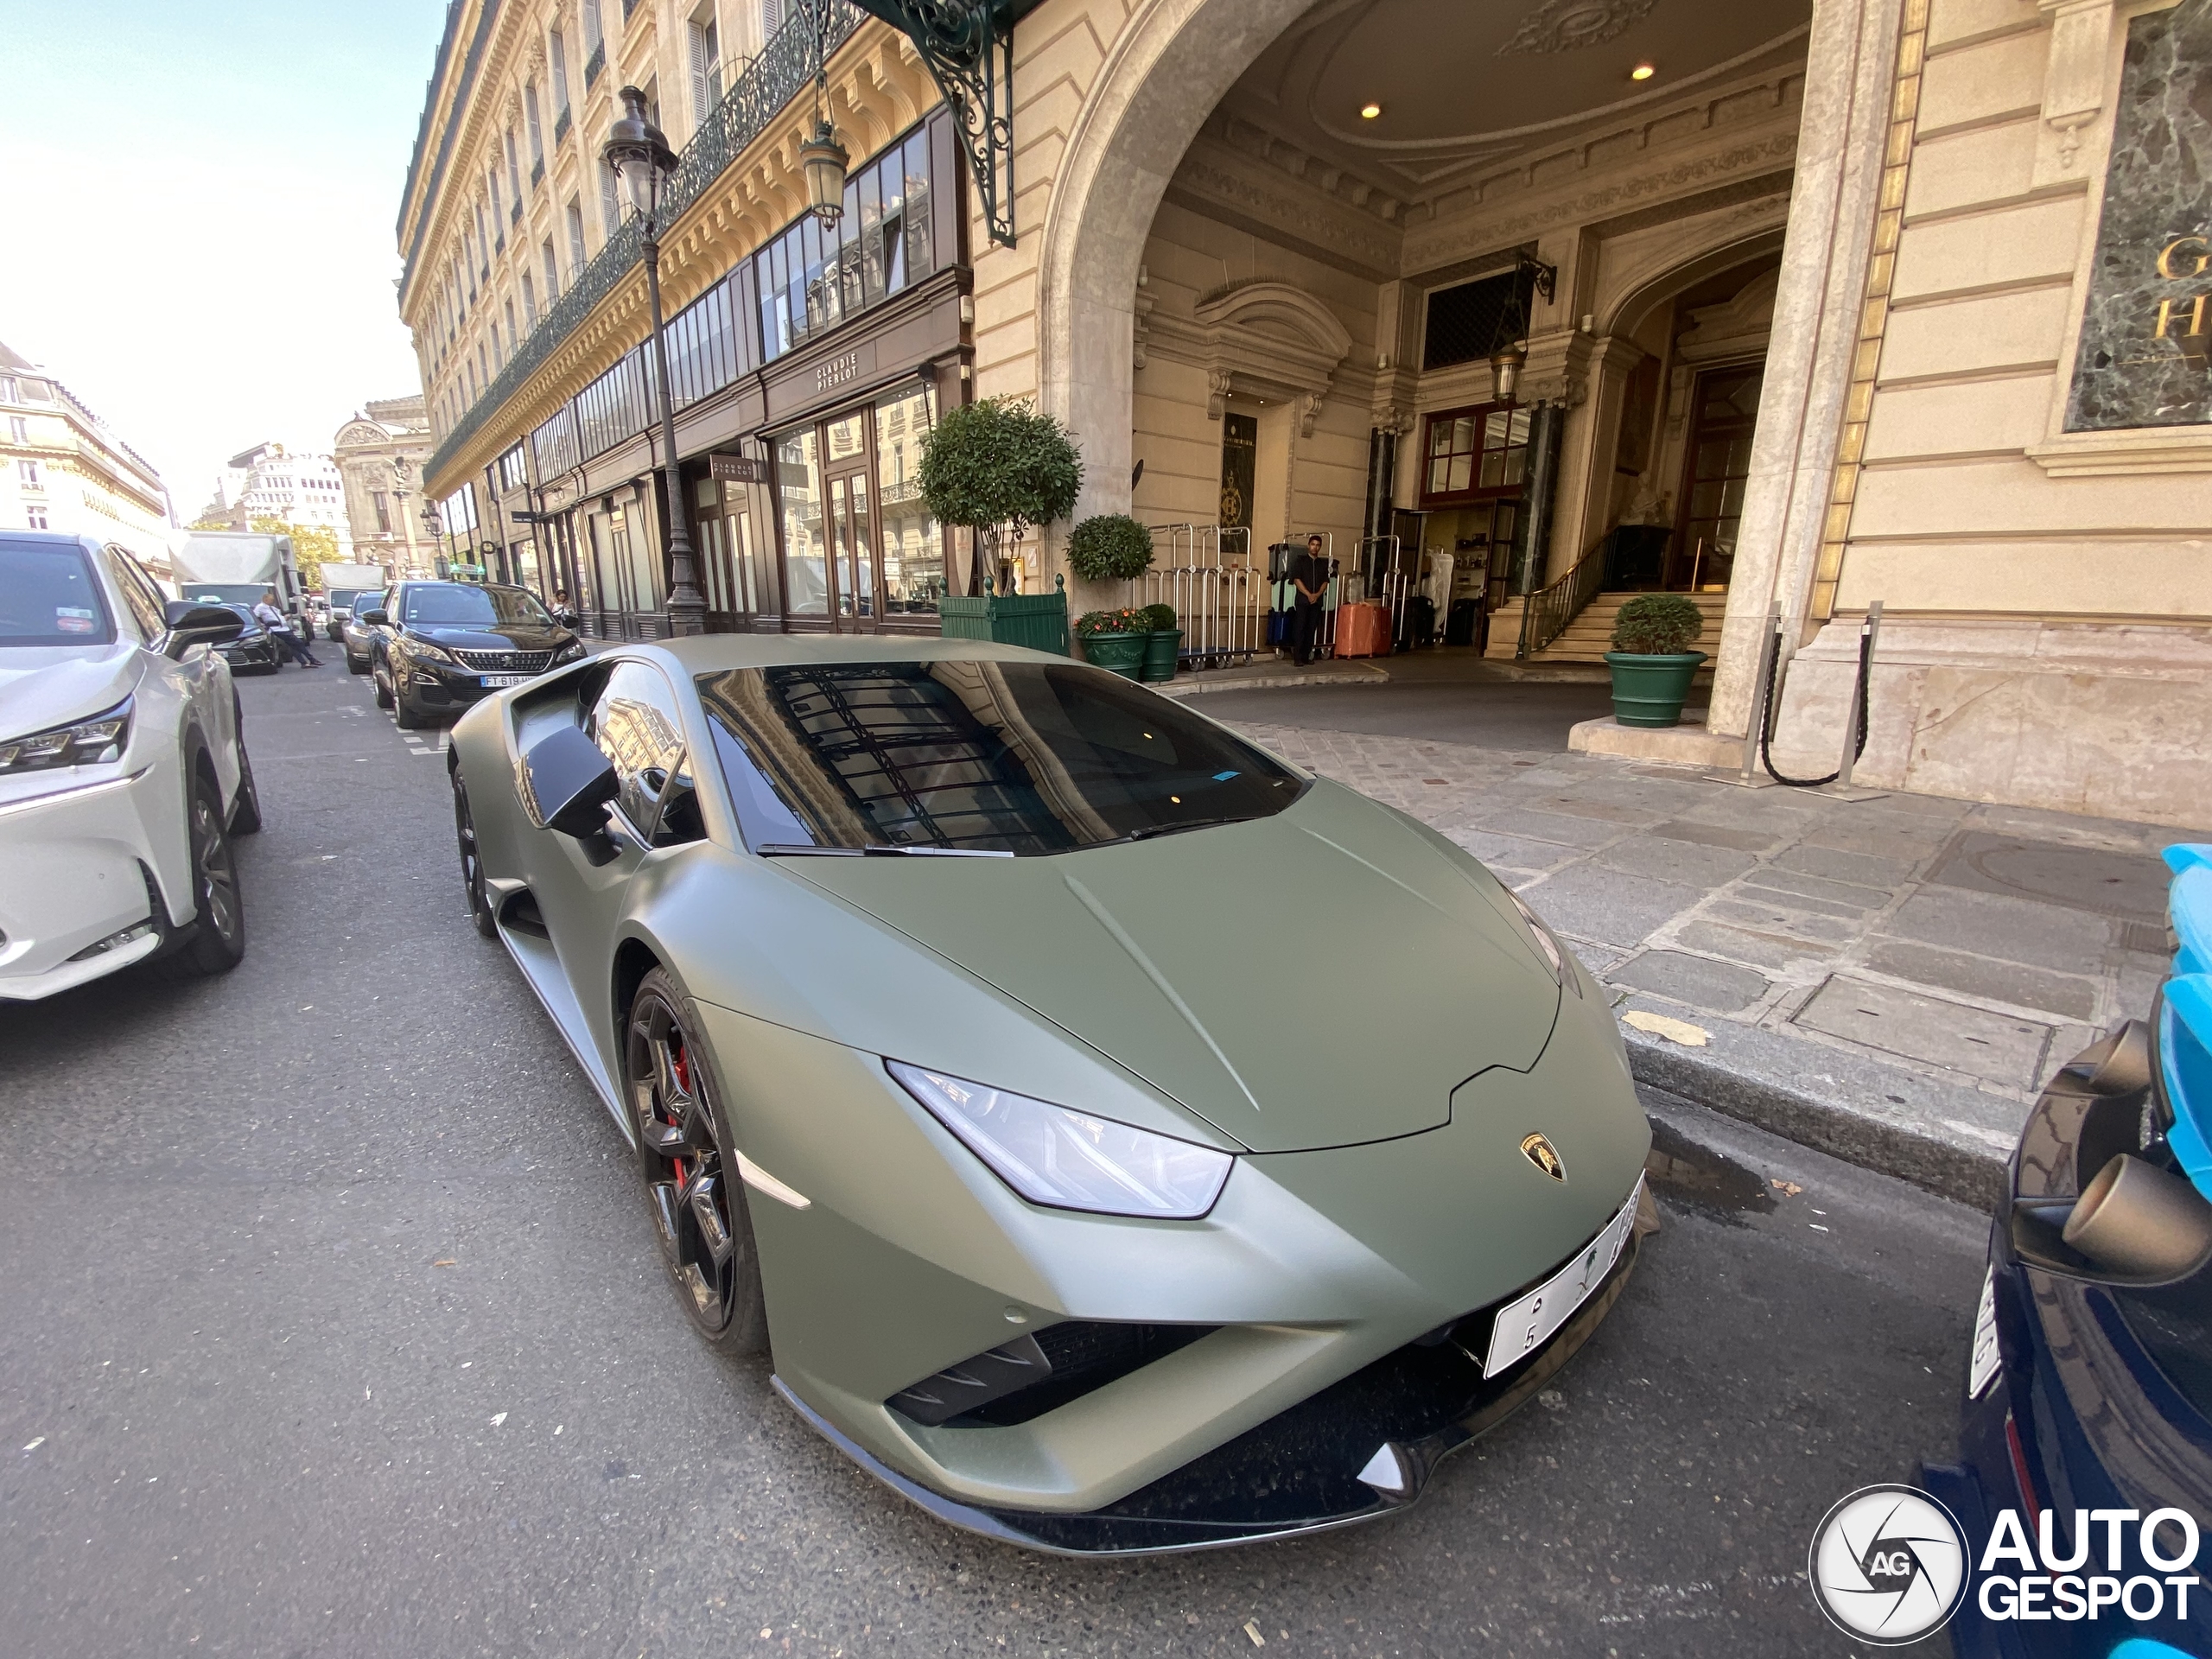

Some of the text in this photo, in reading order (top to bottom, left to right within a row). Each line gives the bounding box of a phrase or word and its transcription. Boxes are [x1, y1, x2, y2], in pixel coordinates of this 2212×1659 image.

[2149, 293, 2212, 341] H
[817, 353, 856, 379] CLAUDIE
[817, 365, 857, 391] PIERLOT
[713, 462, 752, 471] CLAUDIE
[714, 467, 752, 476] PIERLOT
